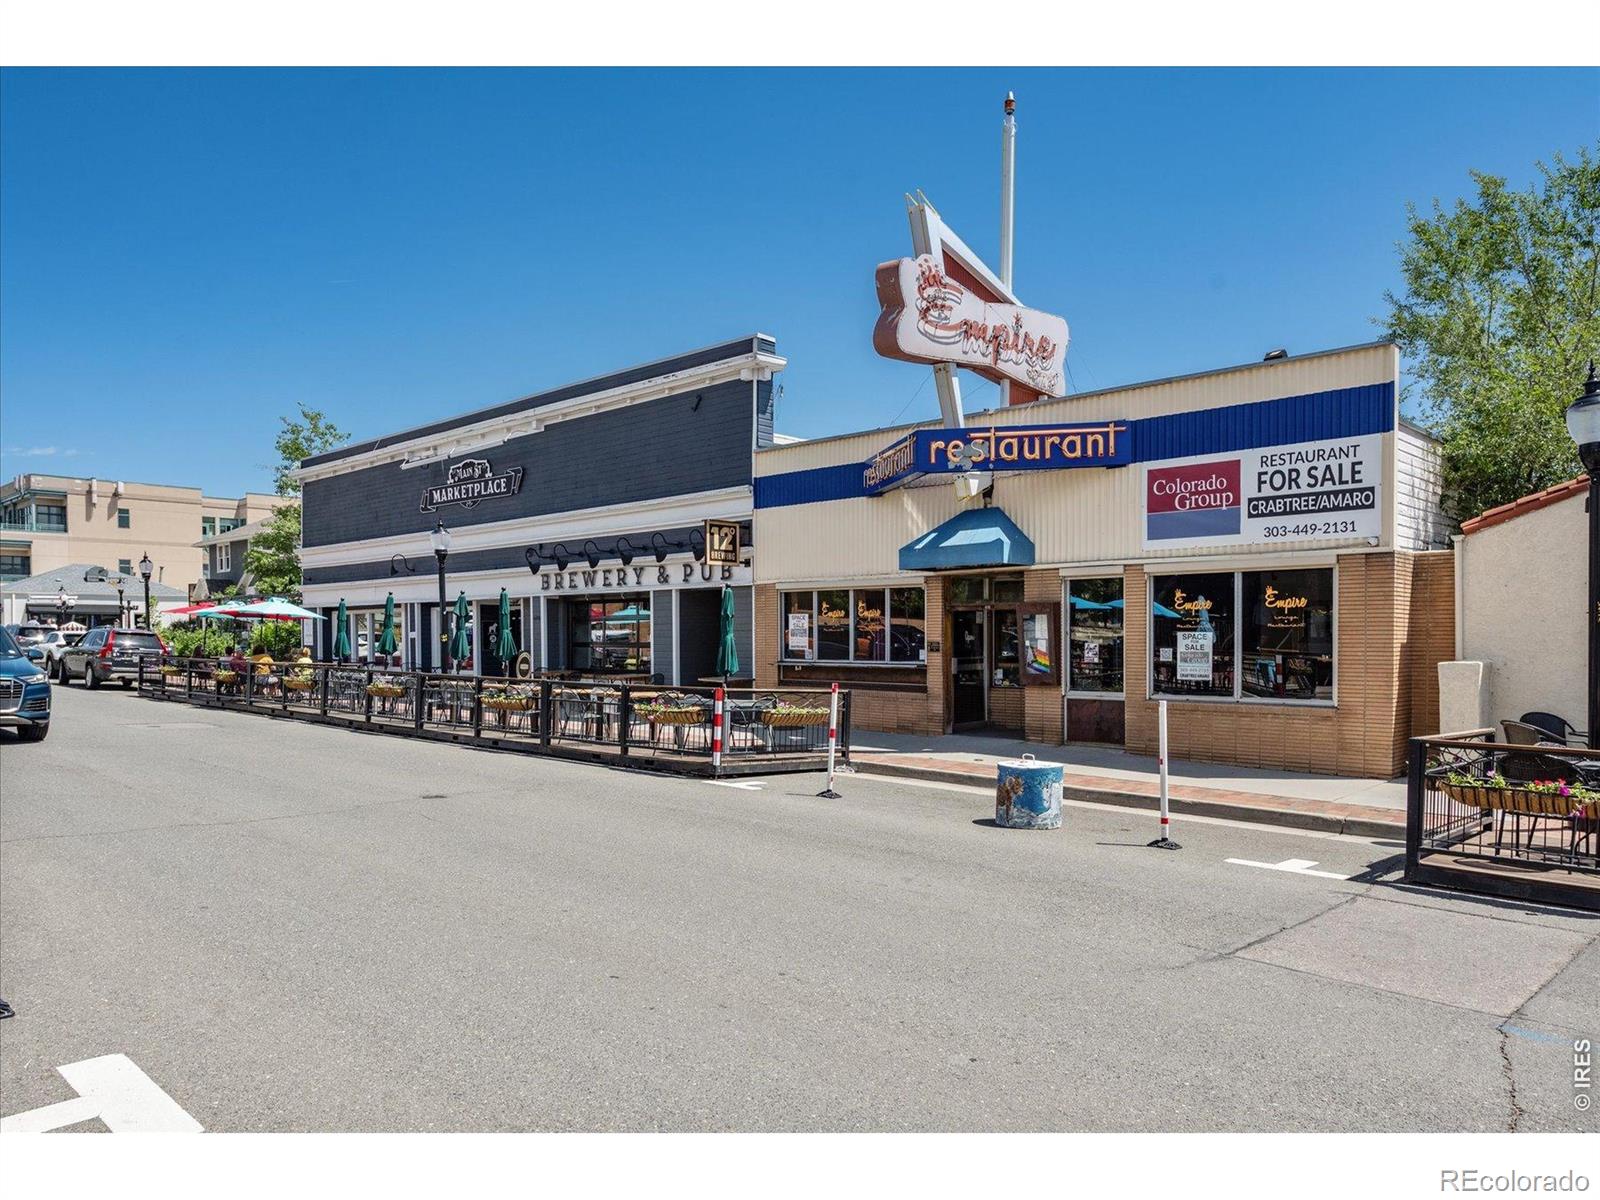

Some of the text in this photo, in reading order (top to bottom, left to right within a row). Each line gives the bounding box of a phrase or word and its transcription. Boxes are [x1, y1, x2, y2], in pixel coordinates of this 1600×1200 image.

[917, 272, 1056, 371] Empire
[930, 422, 1127, 464] restaurant
[1260, 445, 1361, 468] RESTAURANT
[1152, 474, 1227, 496] Colorado
[1257, 461, 1363, 493] FOR SALE
[432, 478, 507, 503] MARKETPLACE
[1174, 491, 1234, 511] Group
[1250, 491, 1374, 515] CRABTREE/AMARO
[1263, 520, 1357, 538] 303-449-2131
[541, 564, 733, 591] BREWERY & PUB
[1265, 590, 1308, 614] Empire
[1182, 633, 1208, 641] SPACE
[1184, 643, 1206, 651] SALE
